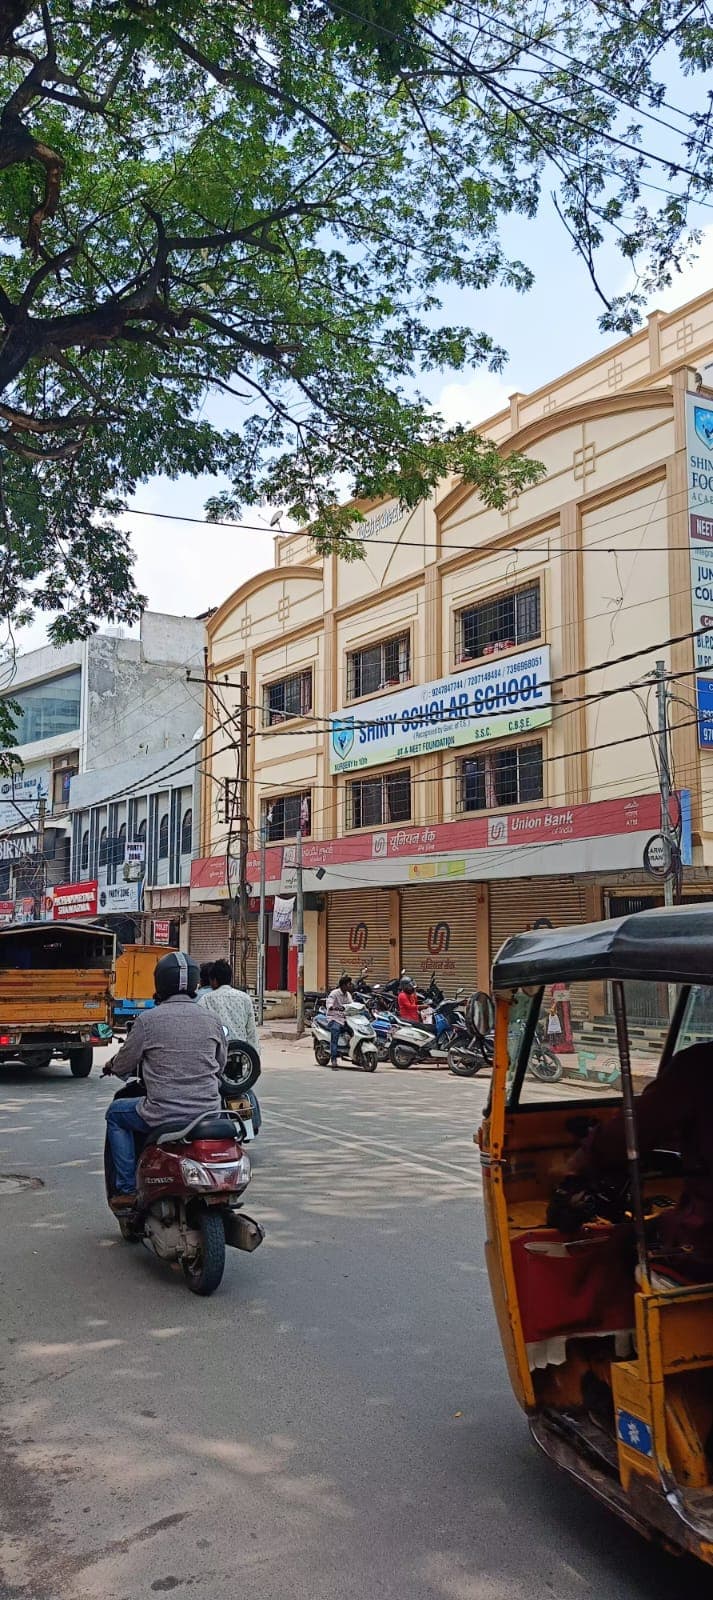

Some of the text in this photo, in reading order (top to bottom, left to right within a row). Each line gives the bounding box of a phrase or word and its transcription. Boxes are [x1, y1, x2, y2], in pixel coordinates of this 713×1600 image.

[359, 673, 543, 744] SHINY SCHOLAR SCHOOL
[423, 736, 455, 752] FOUNDATION
[511, 811, 573, 831] Union Bank
[391, 830, 420, 852] यूनियन
[421, 826, 437, 843] बैंक
